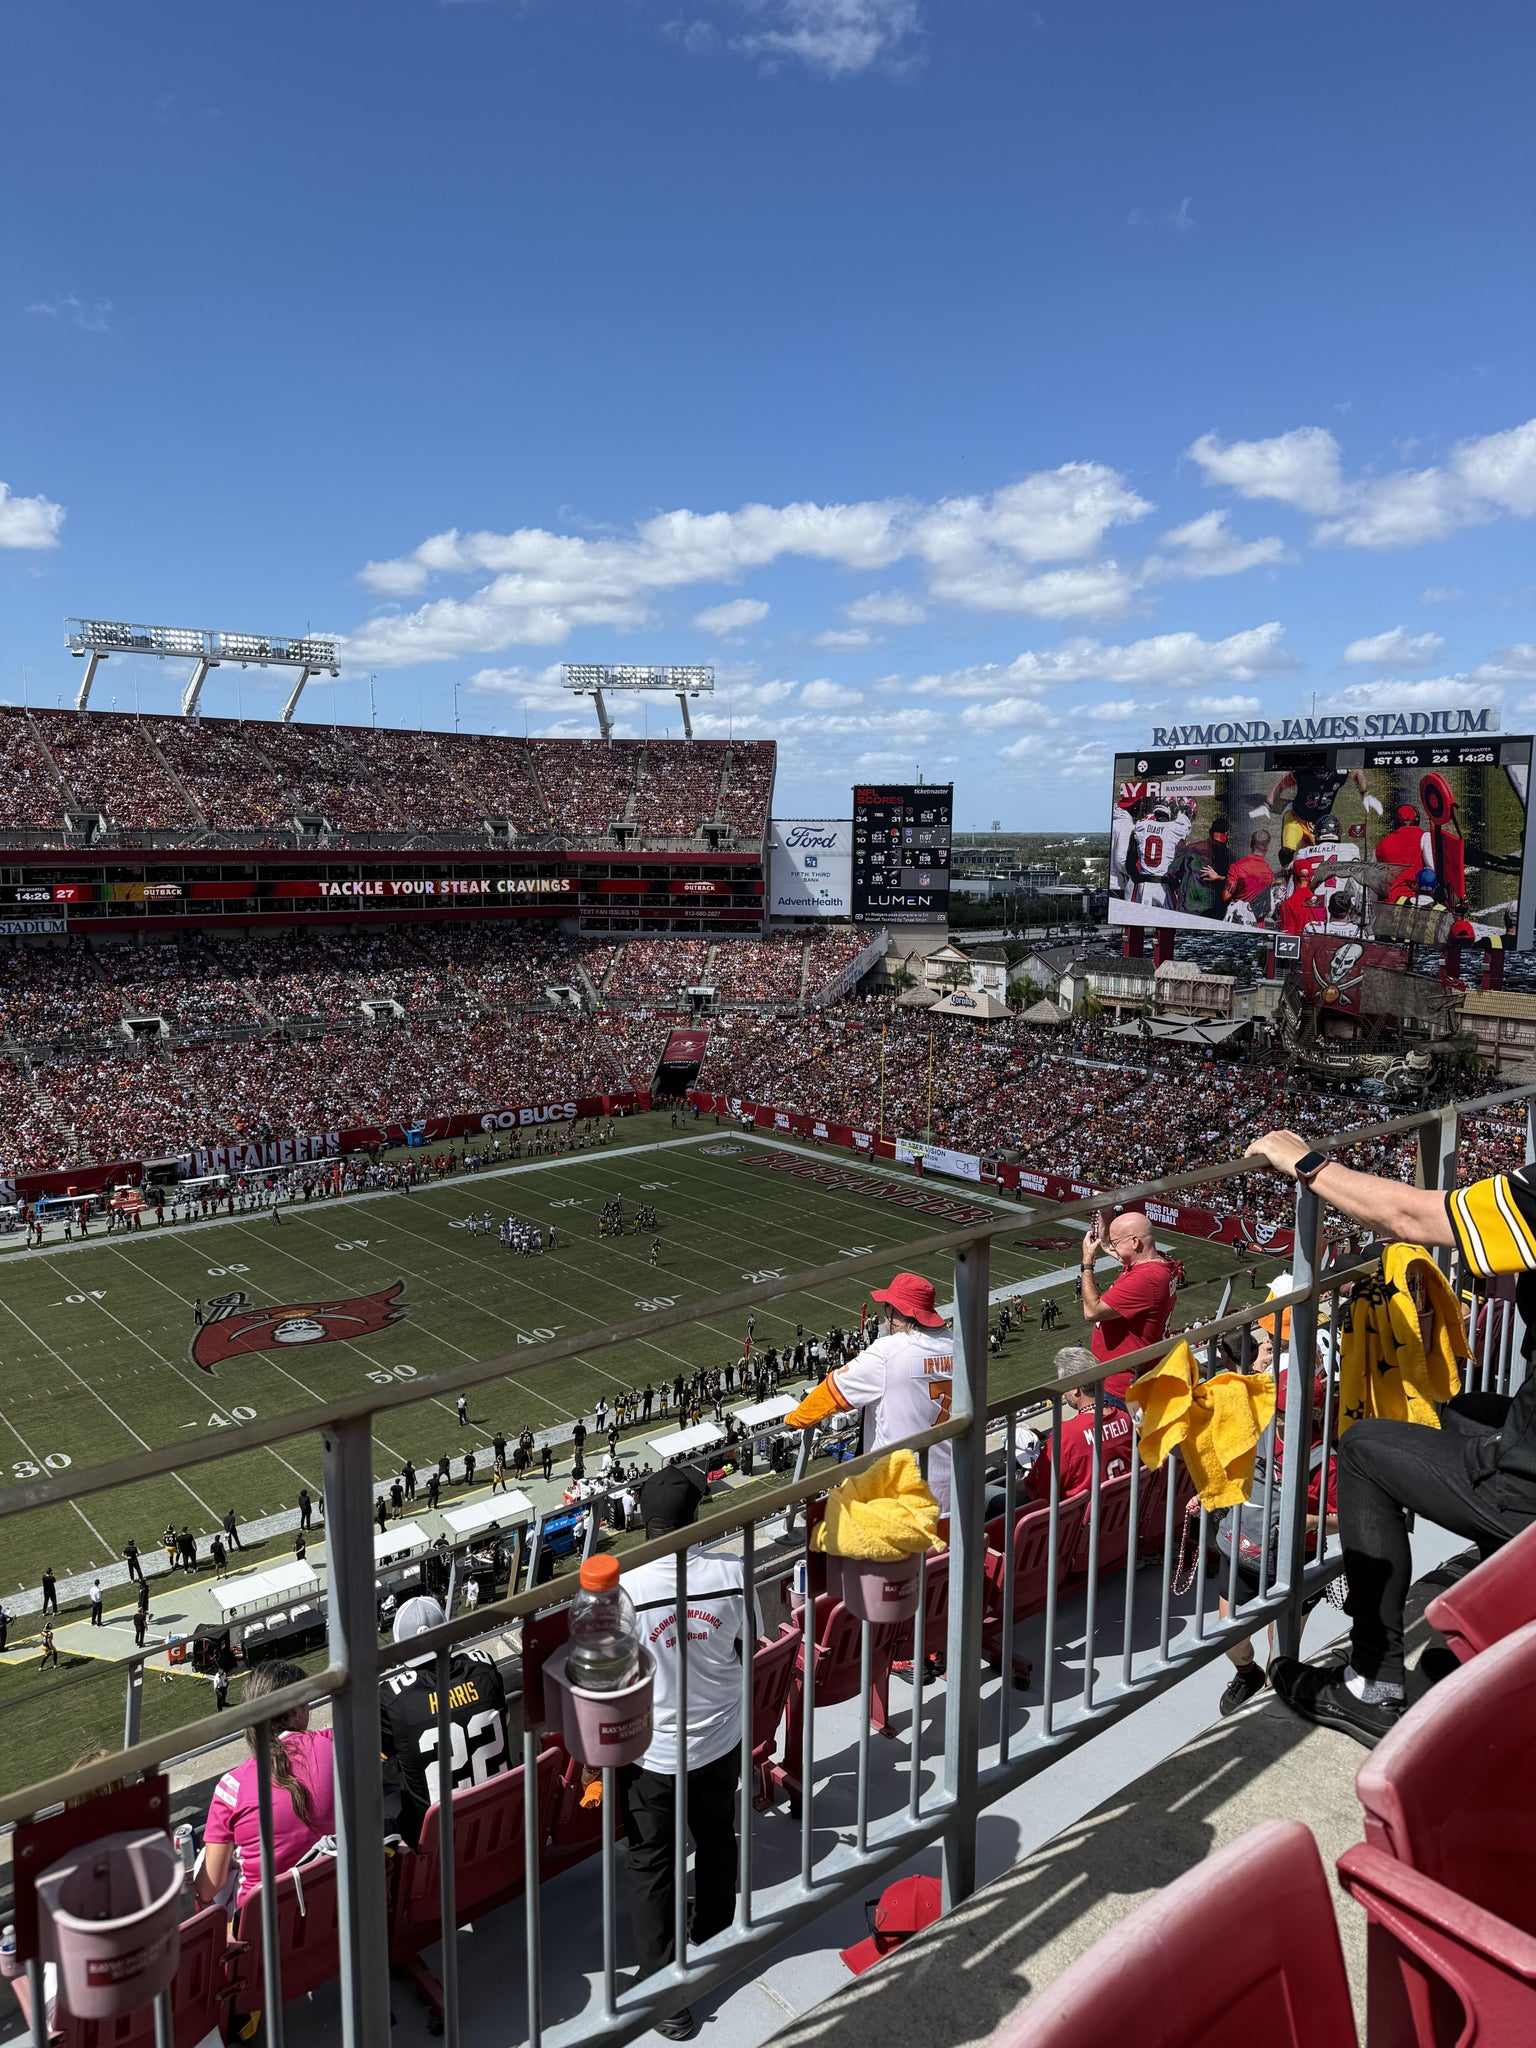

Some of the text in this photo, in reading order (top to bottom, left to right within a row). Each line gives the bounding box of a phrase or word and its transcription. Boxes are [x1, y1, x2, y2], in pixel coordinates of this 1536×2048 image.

[1152, 708, 1491, 747] RAYMOND JAMES STADIUM
[1175, 759, 1184, 768] 0
[1219, 757, 1235, 767] 10
[1373, 756, 1418, 765] 1ST & 10
[1432, 755, 1448, 763] 24
[1458, 753, 1494, 763] 14:26
[857, 796, 904, 804] SCORES
[785, 826, 838, 848] Ford
[1144, 835, 1163, 867] 0
[56, 890, 75, 899] 27
[143, 888, 183, 896] OUTBACK
[319, 879, 571, 896] TACKLE YOUR STEAK CRAVINGS
[15, 893, 50, 901] 14:26
[778, 896, 843, 906] AdventHealth
[868, 895, 930, 906] LUMEN
[1279, 942, 1296, 952] 27
[950, 994, 974, 1007] Corona
[519, 1102, 578, 1126] BUCS
[1019, 1171, 1048, 1185] WINFIELD'S
[1021, 1180, 1046, 1193] WINNERS
[1144, 1201, 1179, 1218] BUCS FLAG
[1146, 1210, 1177, 1226] FOOTBALL
[334, 1239, 370, 1251] 40
[838, 1245, 874, 1258] 10
[207, 1263, 251, 1277] 50
[741, 1268, 781, 1285] 20
[65, 1289, 107, 1304] 40
[634, 1296, 676, 1312] 30
[515, 1327, 557, 1347] 40
[365, 1364, 418, 1385] 50
[206, 1406, 258, 1428] 40
[1083, 1417, 1129, 1446] MFIELD
[11, 1453, 73, 1479] 30
[687, 1609, 723, 1630] MPLIANCE
[171, 1646, 181, 1657] G
[428, 1681, 480, 1715] HRRIS
[418, 1708, 508, 1807] 22
